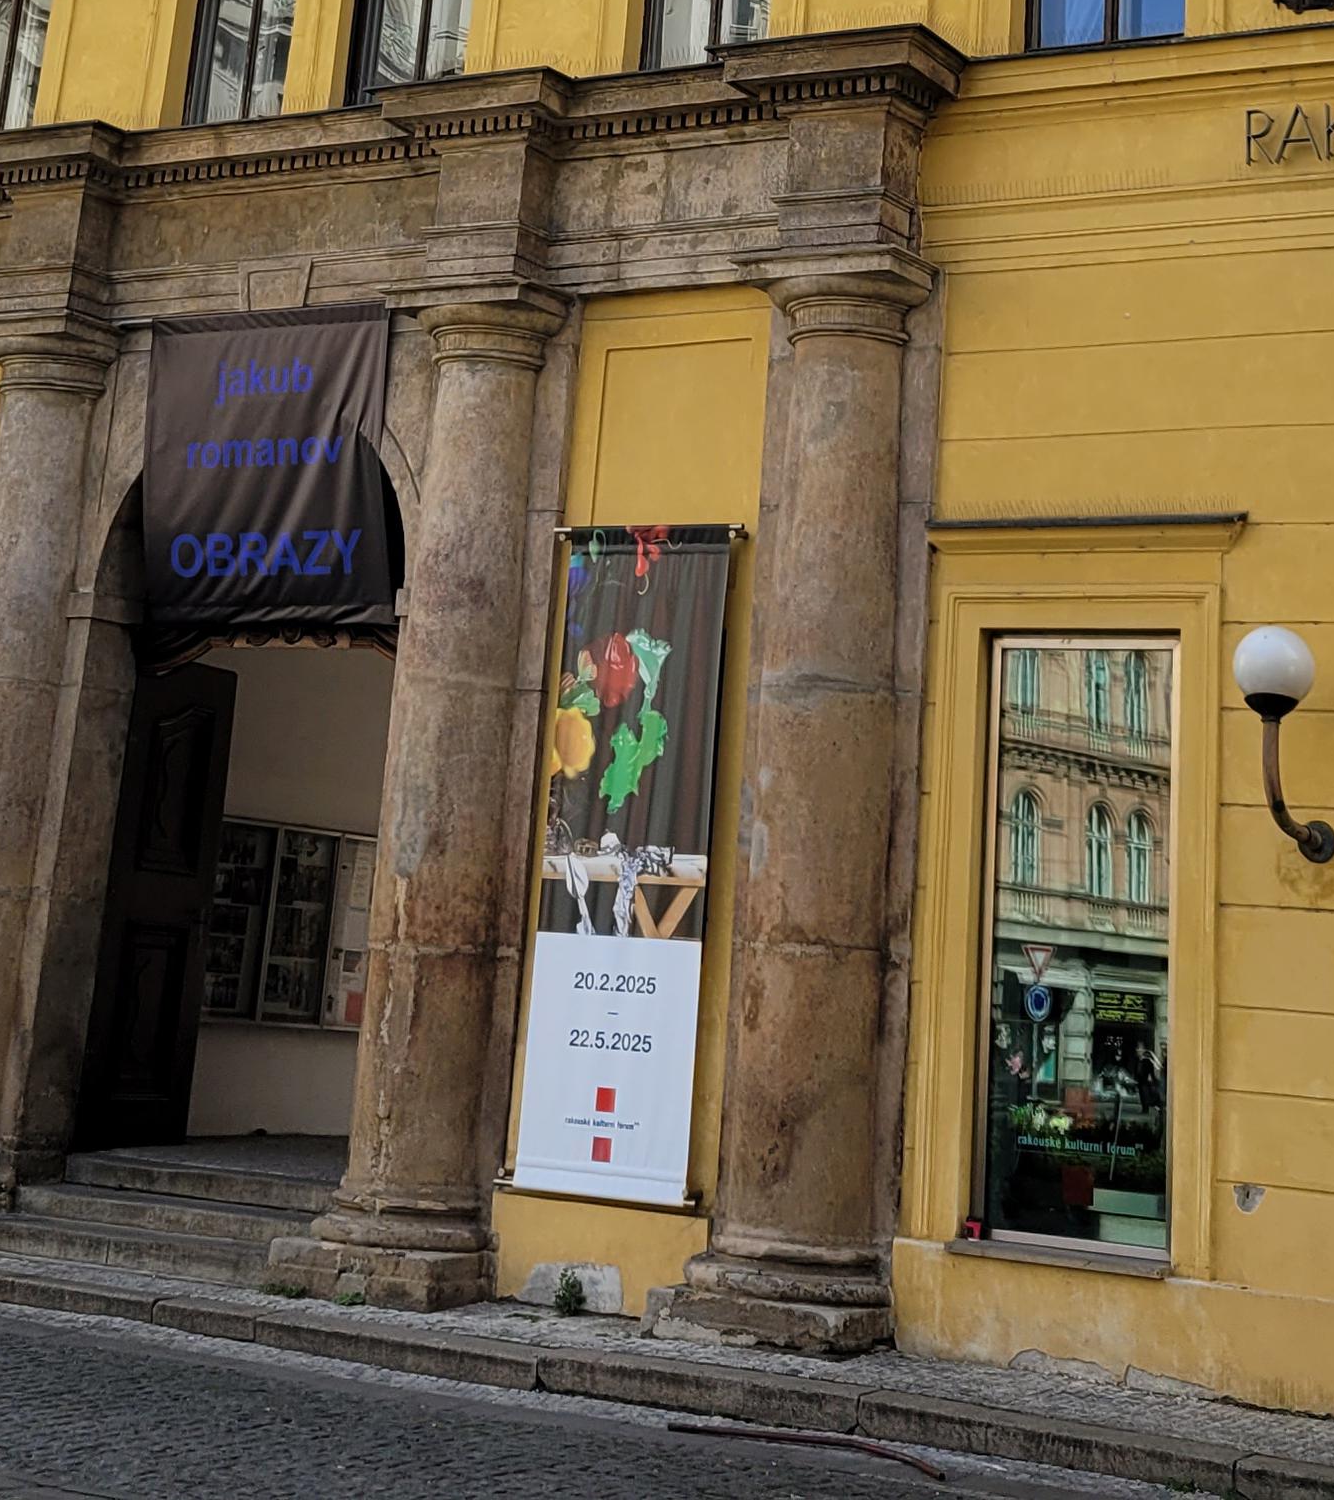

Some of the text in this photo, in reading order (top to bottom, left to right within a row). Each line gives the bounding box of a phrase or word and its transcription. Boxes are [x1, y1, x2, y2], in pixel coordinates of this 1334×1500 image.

[215, 357, 315, 408] jakub
[186, 435, 344, 469] romanov
[171, 528, 363, 578] OBRAZY
[574, 972, 657, 995] 20.2.2025
[569, 1029, 652, 1053] 22.5.2025
